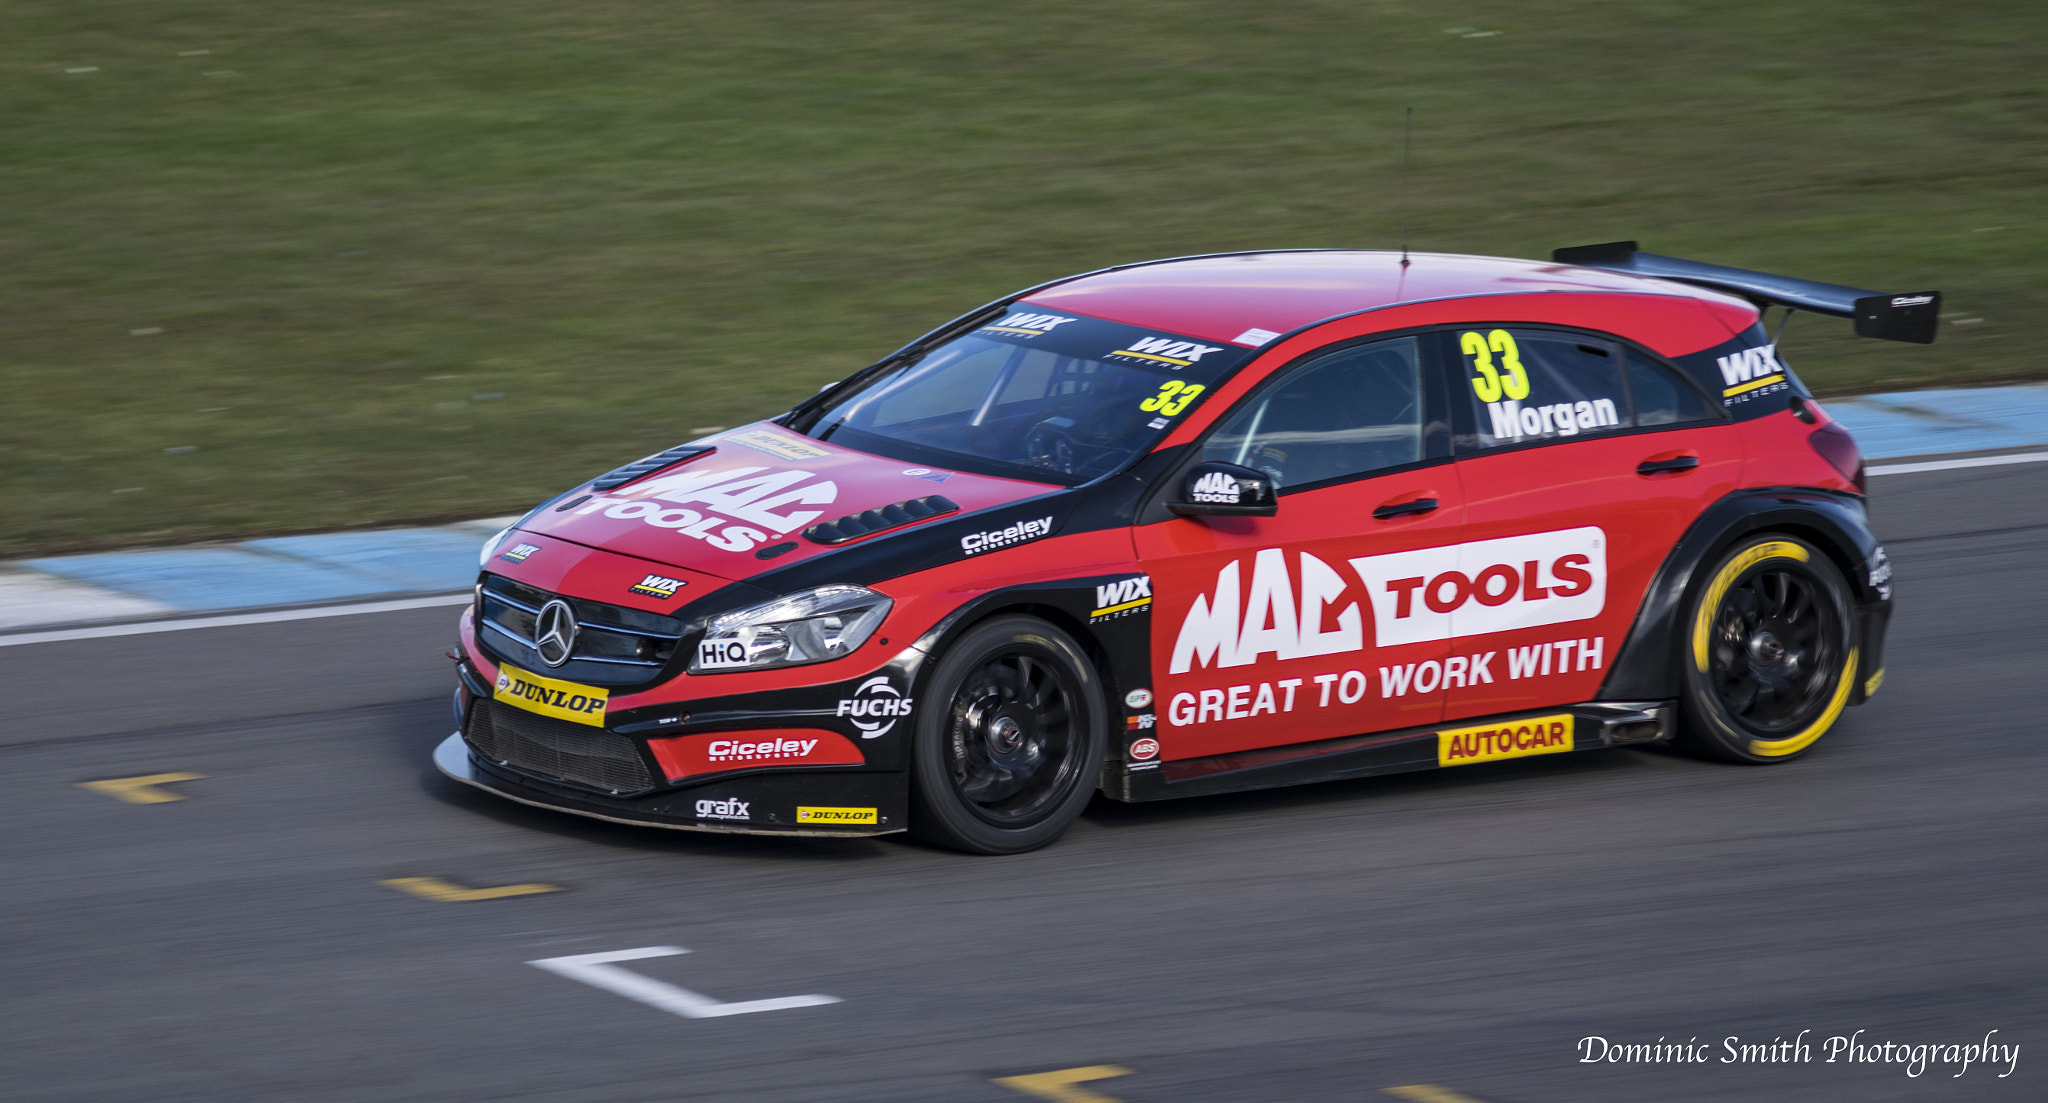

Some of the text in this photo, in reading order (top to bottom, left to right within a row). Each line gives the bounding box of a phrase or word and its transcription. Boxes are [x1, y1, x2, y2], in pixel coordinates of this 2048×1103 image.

[997, 312, 1079, 331] WIX
[1101, 353, 1186, 371] FILTERS
[1126, 336, 1225, 362] WIX
[1459, 329, 1531, 403] 33
[1715, 343, 1785, 387] WIX
[1139, 379, 1207, 417] 33
[1723, 381, 1790, 408] FILTERS
[1486, 397, 1620, 439] Morgan
[1192, 472, 1240, 495] MAC
[609, 466, 838, 535] MAC
[1192, 493, 1240, 504] TOOLS
[573, 496, 768, 552] TOOLS
[960, 516, 1054, 551] Ciceley
[510, 542, 541, 558] WIX
[964, 529, 1043, 555] MOTORSPORT
[639, 573, 688, 594] WIX
[1096, 575, 1152, 608] WIX
[1089, 604, 1150, 626] FILTERS
[1168, 547, 1364, 675] MAC
[1385, 553, 1593, 619] TOOLS
[701, 640, 747, 665] HiQ
[1168, 635, 1605, 727] GREAT TO WORK WITH
[510, 678, 606, 715] DUNLOP
[835, 697, 913, 717] FUCHS
[708, 737, 819, 757] Ciceley
[1133, 743, 1157, 754] ABS
[1447, 720, 1566, 761] AUTOCAR
[708, 750, 802, 762] MOTORSPORT
[695, 797, 750, 818] grafx
[812, 810, 874, 821] DUNLOP
